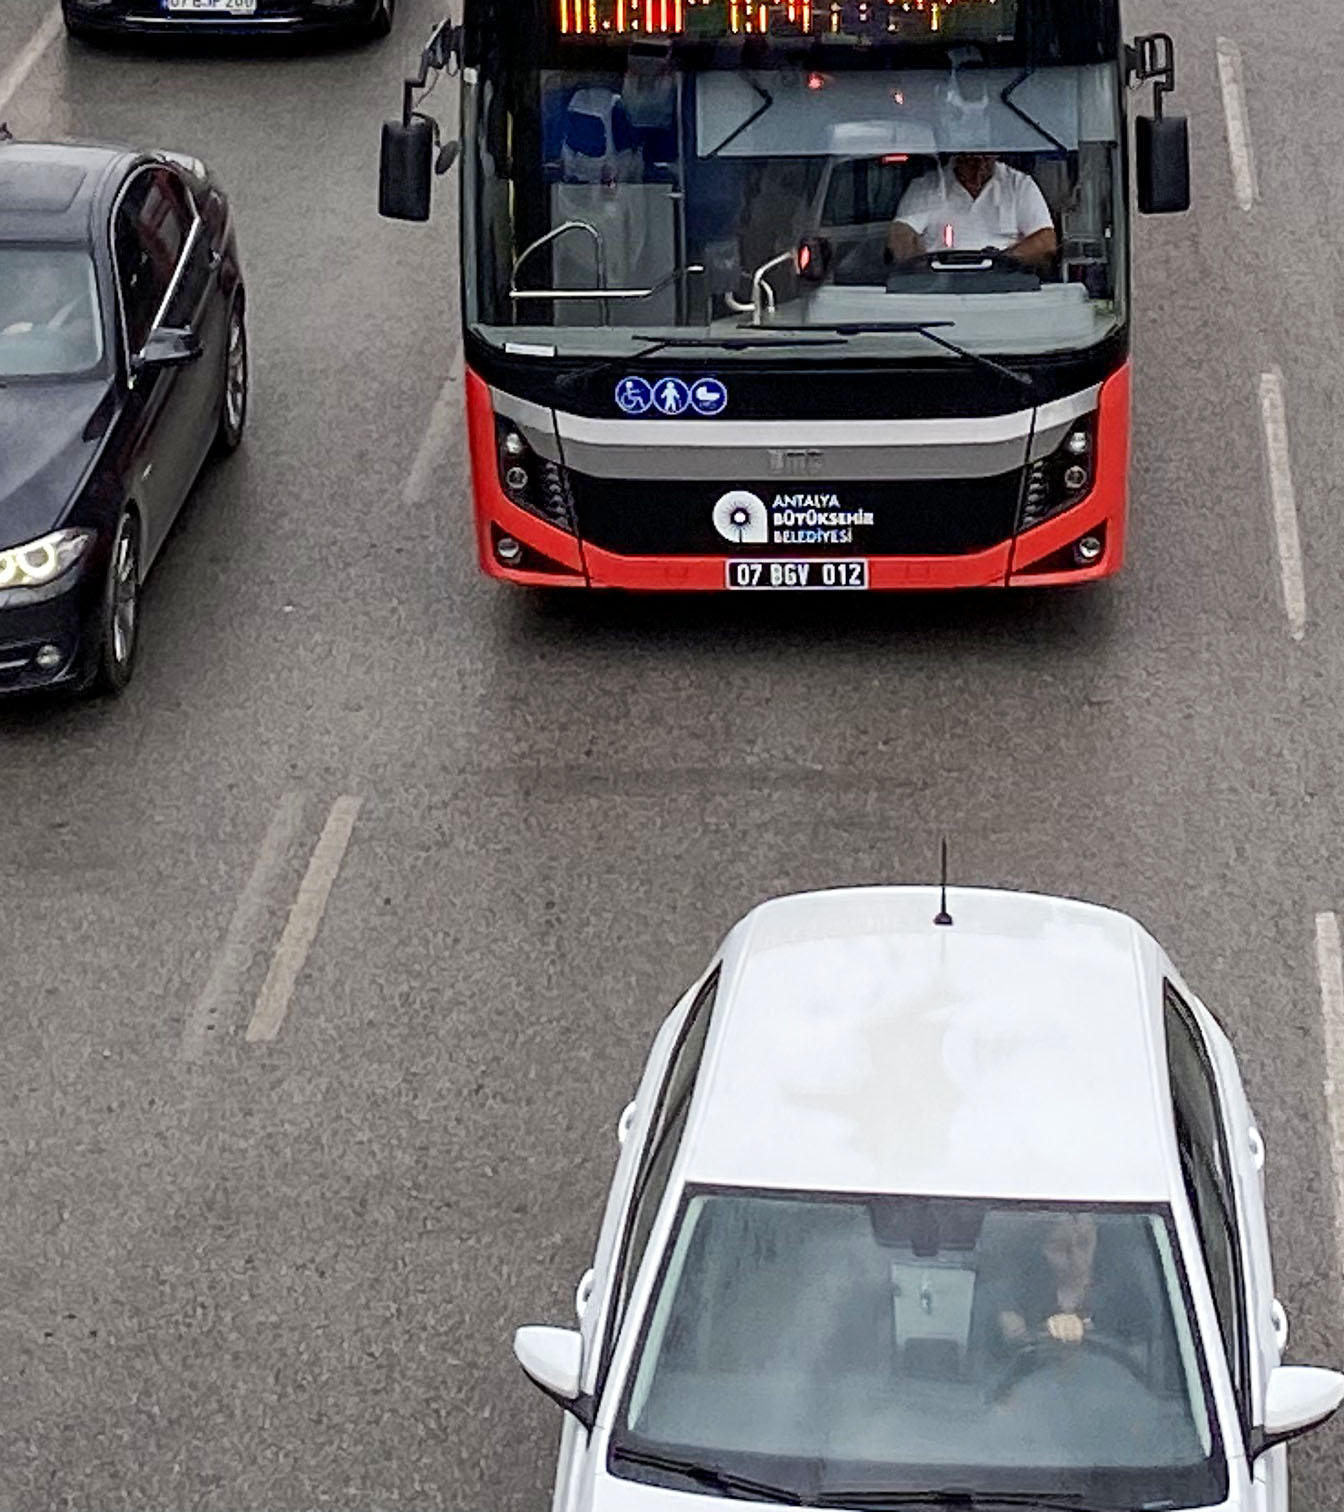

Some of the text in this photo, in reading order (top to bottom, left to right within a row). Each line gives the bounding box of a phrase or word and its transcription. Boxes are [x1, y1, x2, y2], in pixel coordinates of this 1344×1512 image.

[772, 494, 840, 508] ANTALYA
[773, 527, 853, 544] BELEDİYESİ
[737, 564, 861, 585] 07 BGV 012
